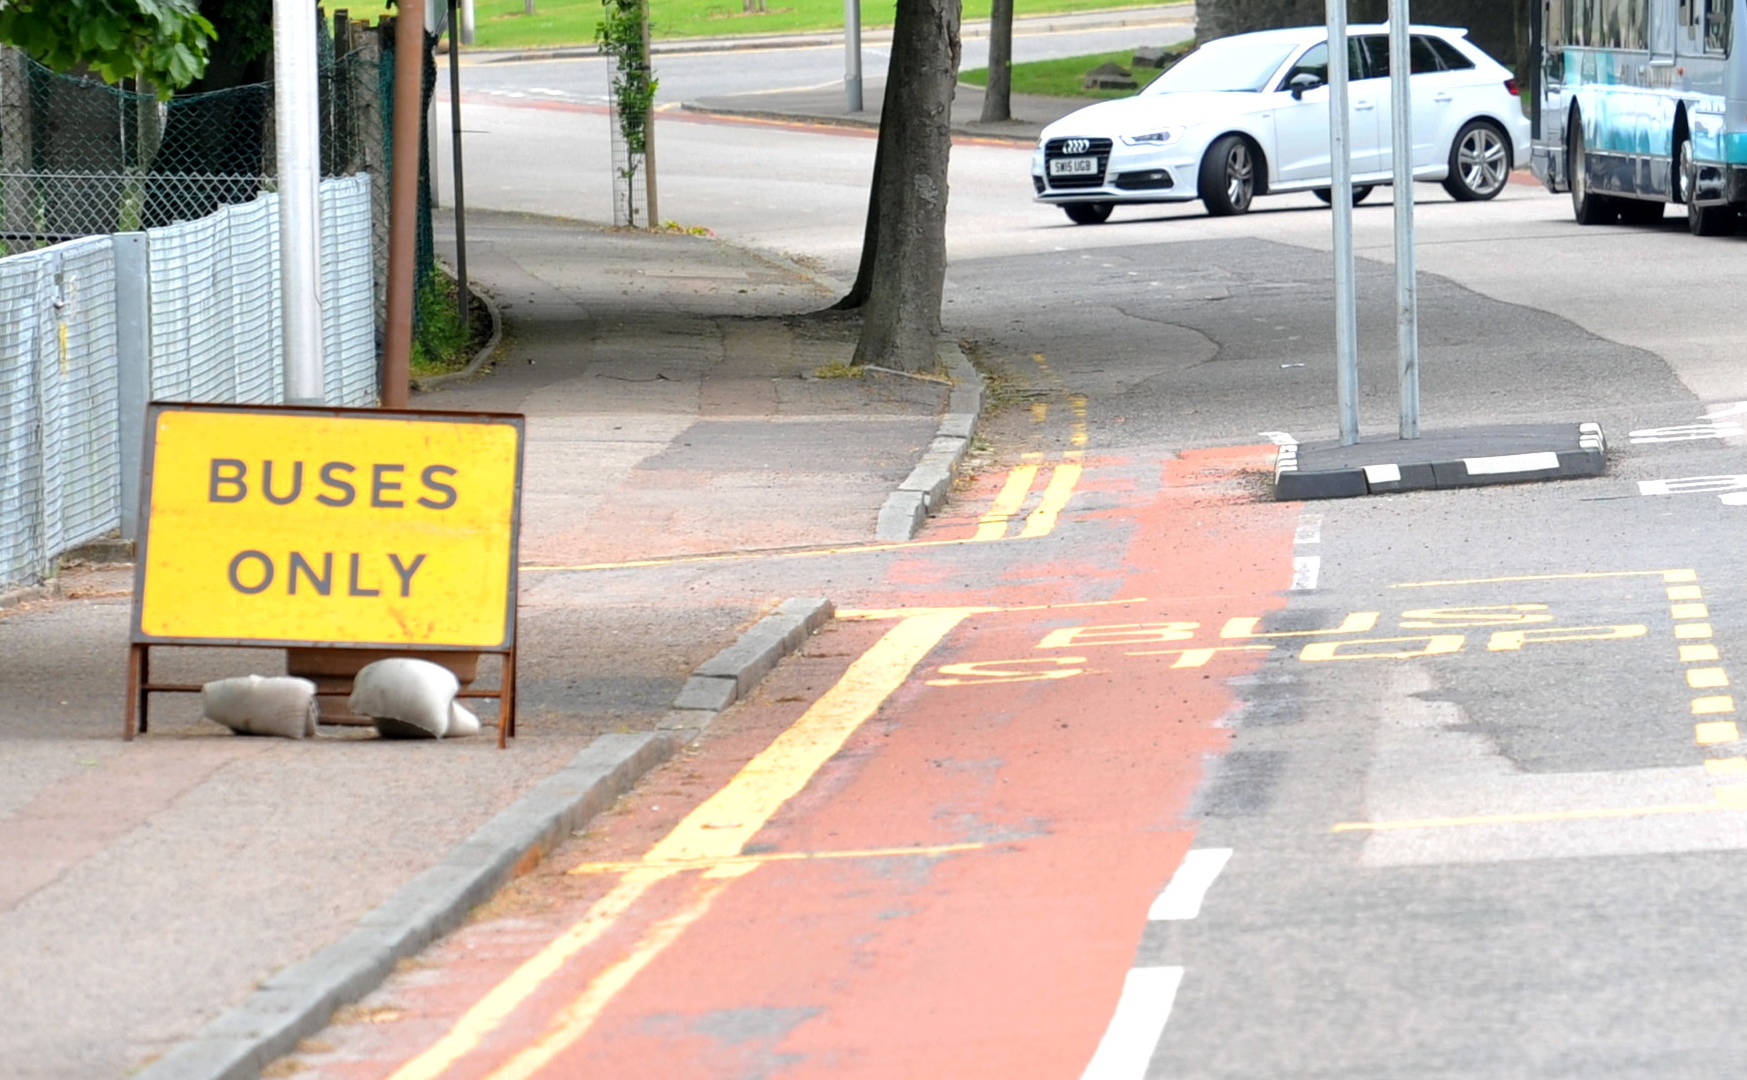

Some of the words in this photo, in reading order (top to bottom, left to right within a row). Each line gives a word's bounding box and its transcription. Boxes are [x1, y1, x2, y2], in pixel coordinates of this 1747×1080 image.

[208, 458, 458, 510] BUSES
[227, 549, 428, 597] ONLY
[1034, 604, 1554, 648] BUS
[924, 623, 1648, 687] STOP
